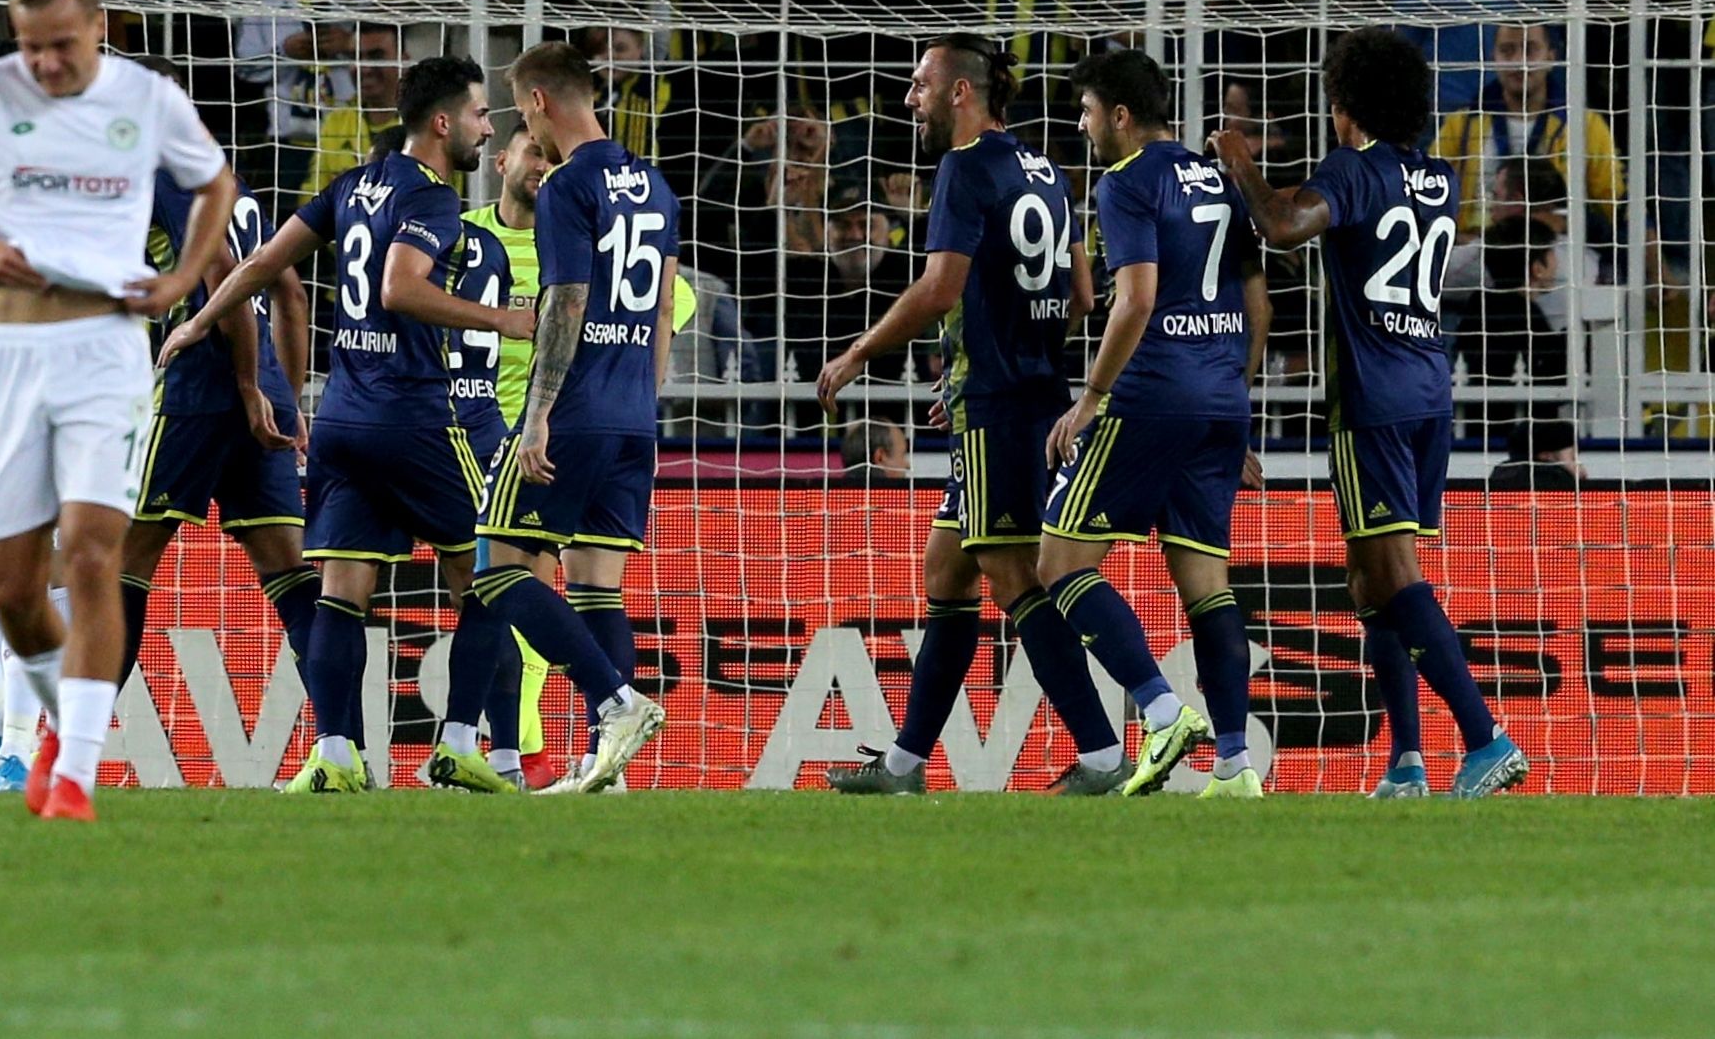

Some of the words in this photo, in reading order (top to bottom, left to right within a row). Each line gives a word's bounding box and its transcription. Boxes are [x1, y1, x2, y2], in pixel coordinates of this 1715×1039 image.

[1173, 161, 1225, 195] halley
[341, 224, 372, 321] 3
[597, 213, 666, 312] 15
[1191, 203, 1232, 302] 7
[1363, 206, 1455, 313] 20
[1163, 314, 1210, 336] OZAN
